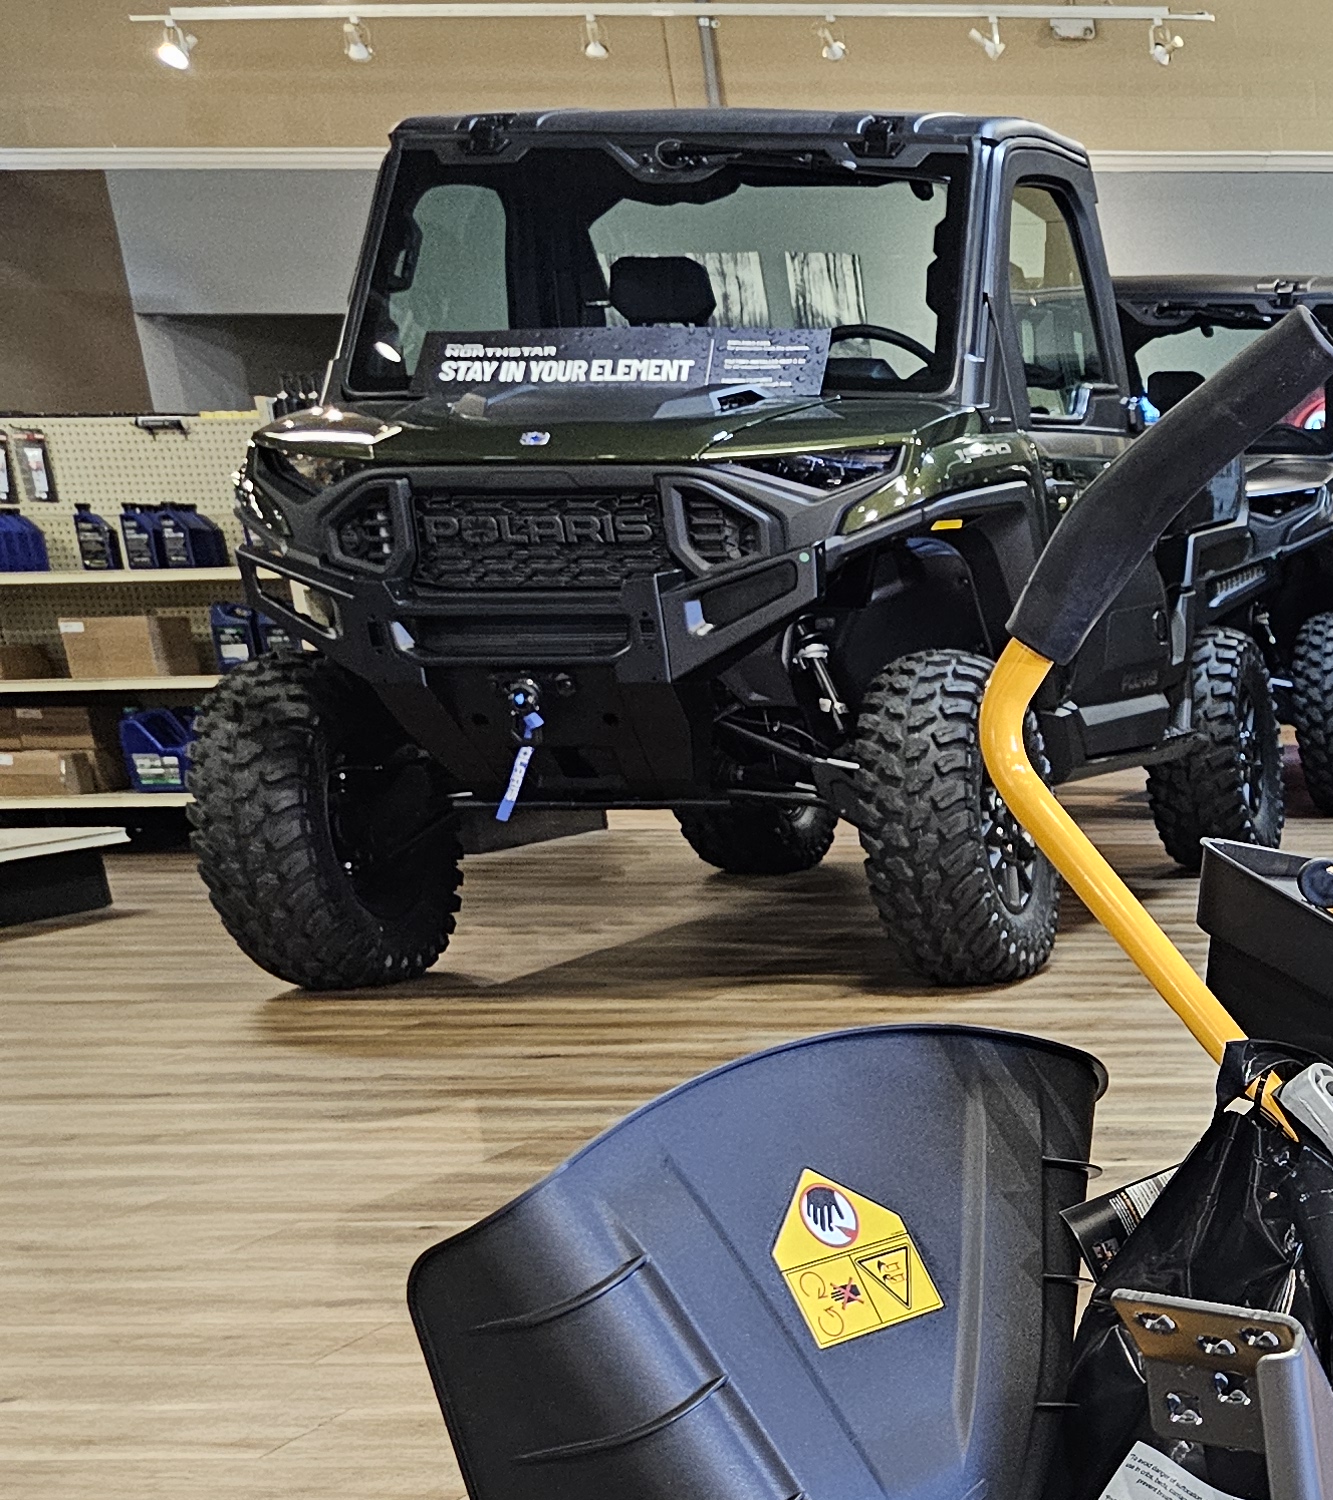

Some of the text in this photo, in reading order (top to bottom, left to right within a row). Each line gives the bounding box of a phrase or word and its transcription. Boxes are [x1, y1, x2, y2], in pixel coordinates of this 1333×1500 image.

[438, 358, 697, 383] STAY IN YOUR ELEMENT
[424, 514, 653, 544] POLARIS
